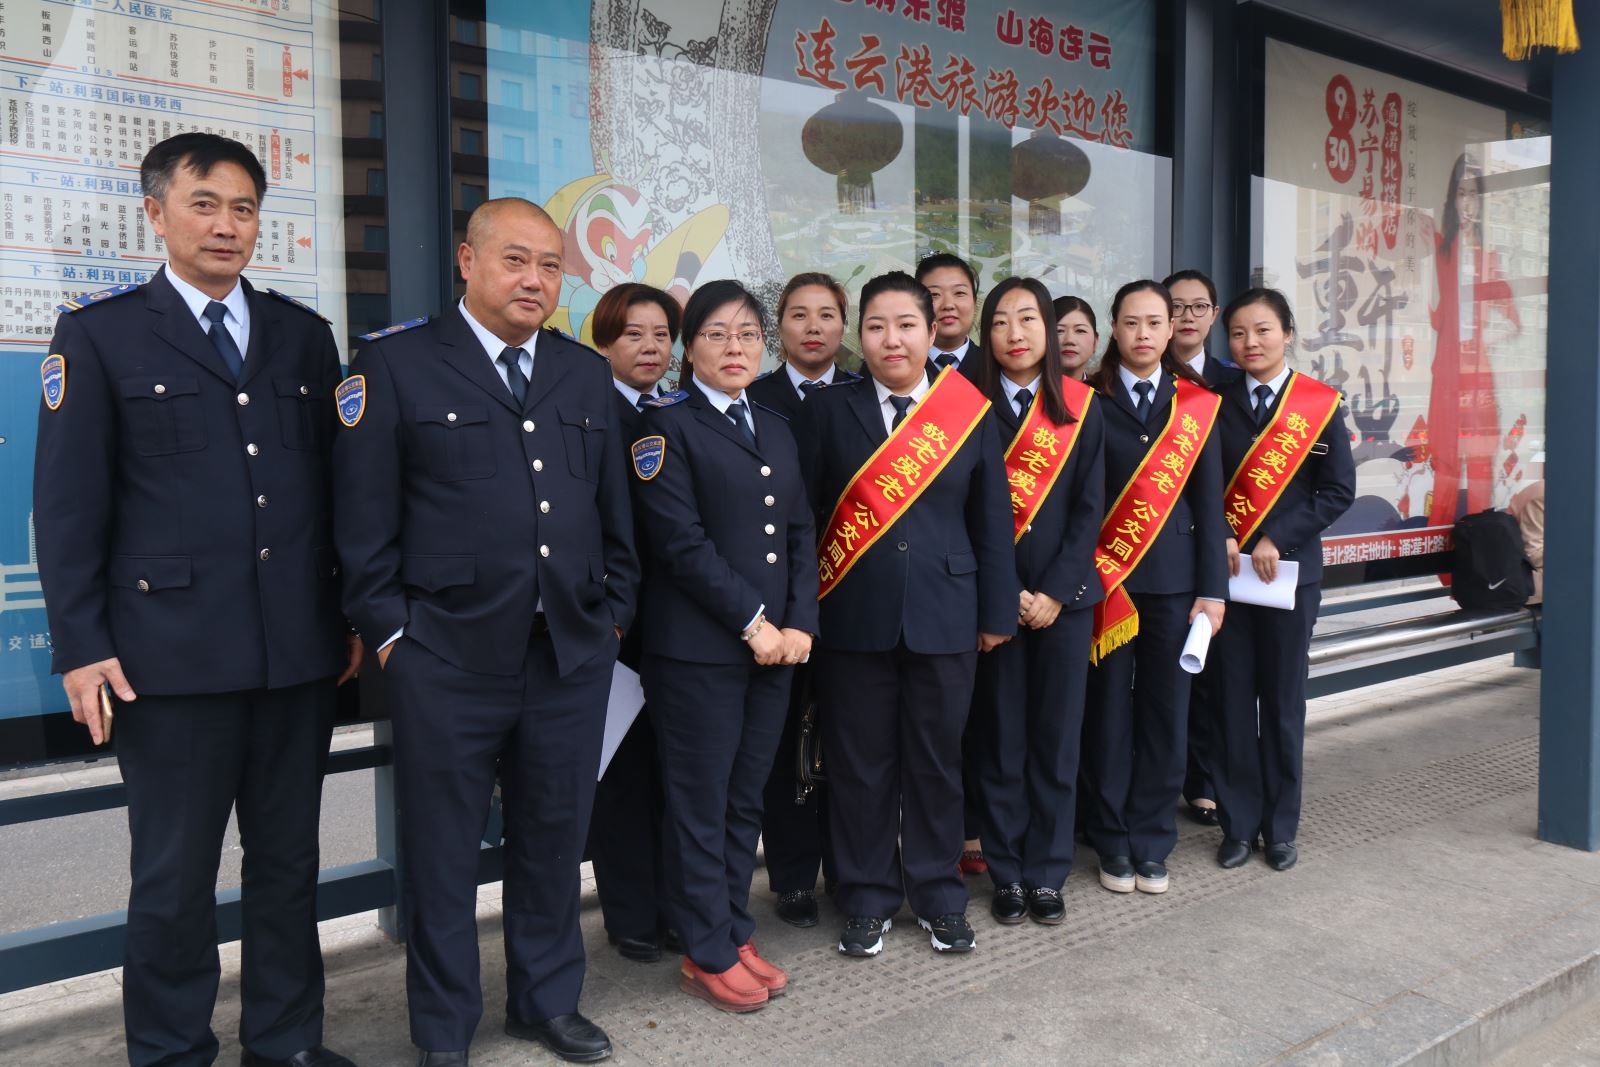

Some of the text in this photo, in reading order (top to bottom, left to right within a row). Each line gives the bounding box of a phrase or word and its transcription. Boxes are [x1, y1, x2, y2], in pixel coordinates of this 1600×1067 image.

[128, 26, 138, 72] 客运南站
[995, 9, 1112, 70] 山海连云
[794, 17, 1135, 149] 连云港旅游欢迎您
[1328, 136, 1350, 171] 30
[31, 264, 154, 284] 下一站:利玛国际
[86, 249, 117, 258] BUS
[1096, 499, 1159, 576] 公交同行
